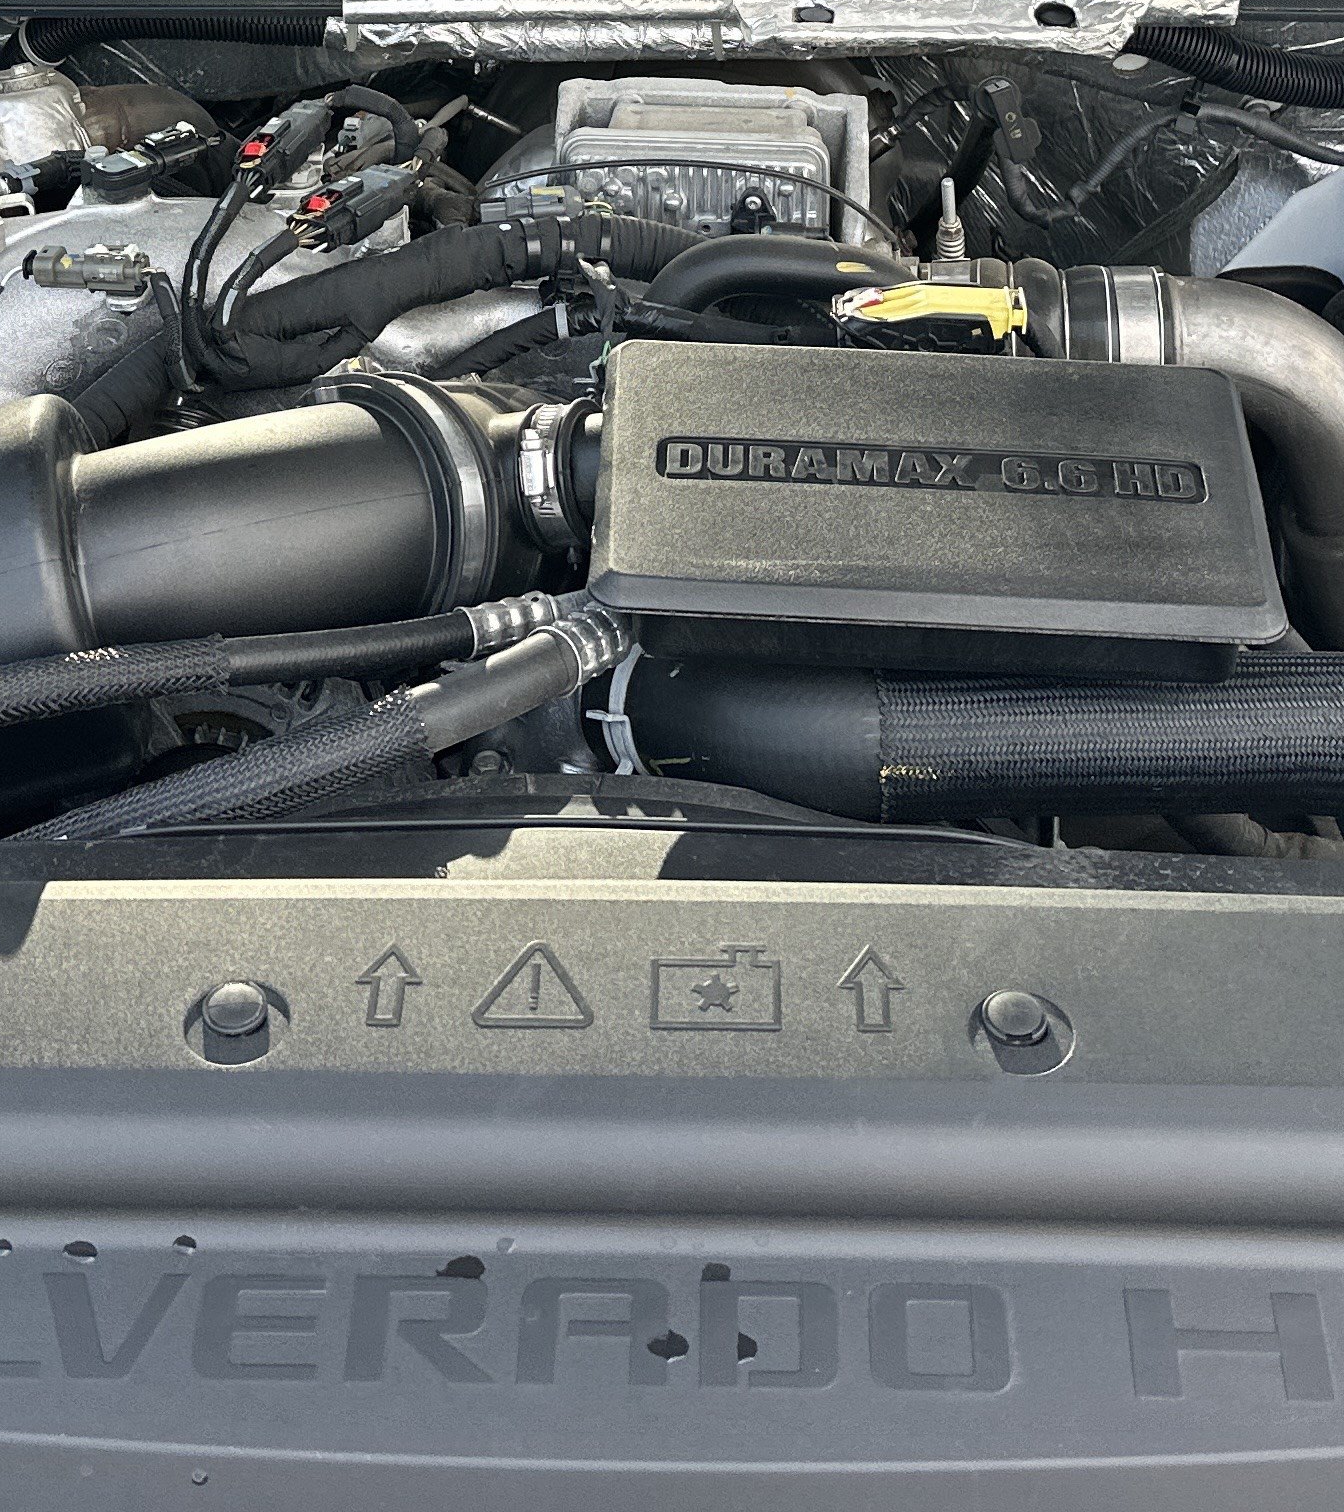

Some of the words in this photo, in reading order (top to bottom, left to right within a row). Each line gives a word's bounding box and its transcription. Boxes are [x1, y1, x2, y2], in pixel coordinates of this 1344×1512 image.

[666, 441, 974, 488] DURAMAX
[1000, 456, 1099, 495] 6.6
[1113, 461, 1202, 499] HD
